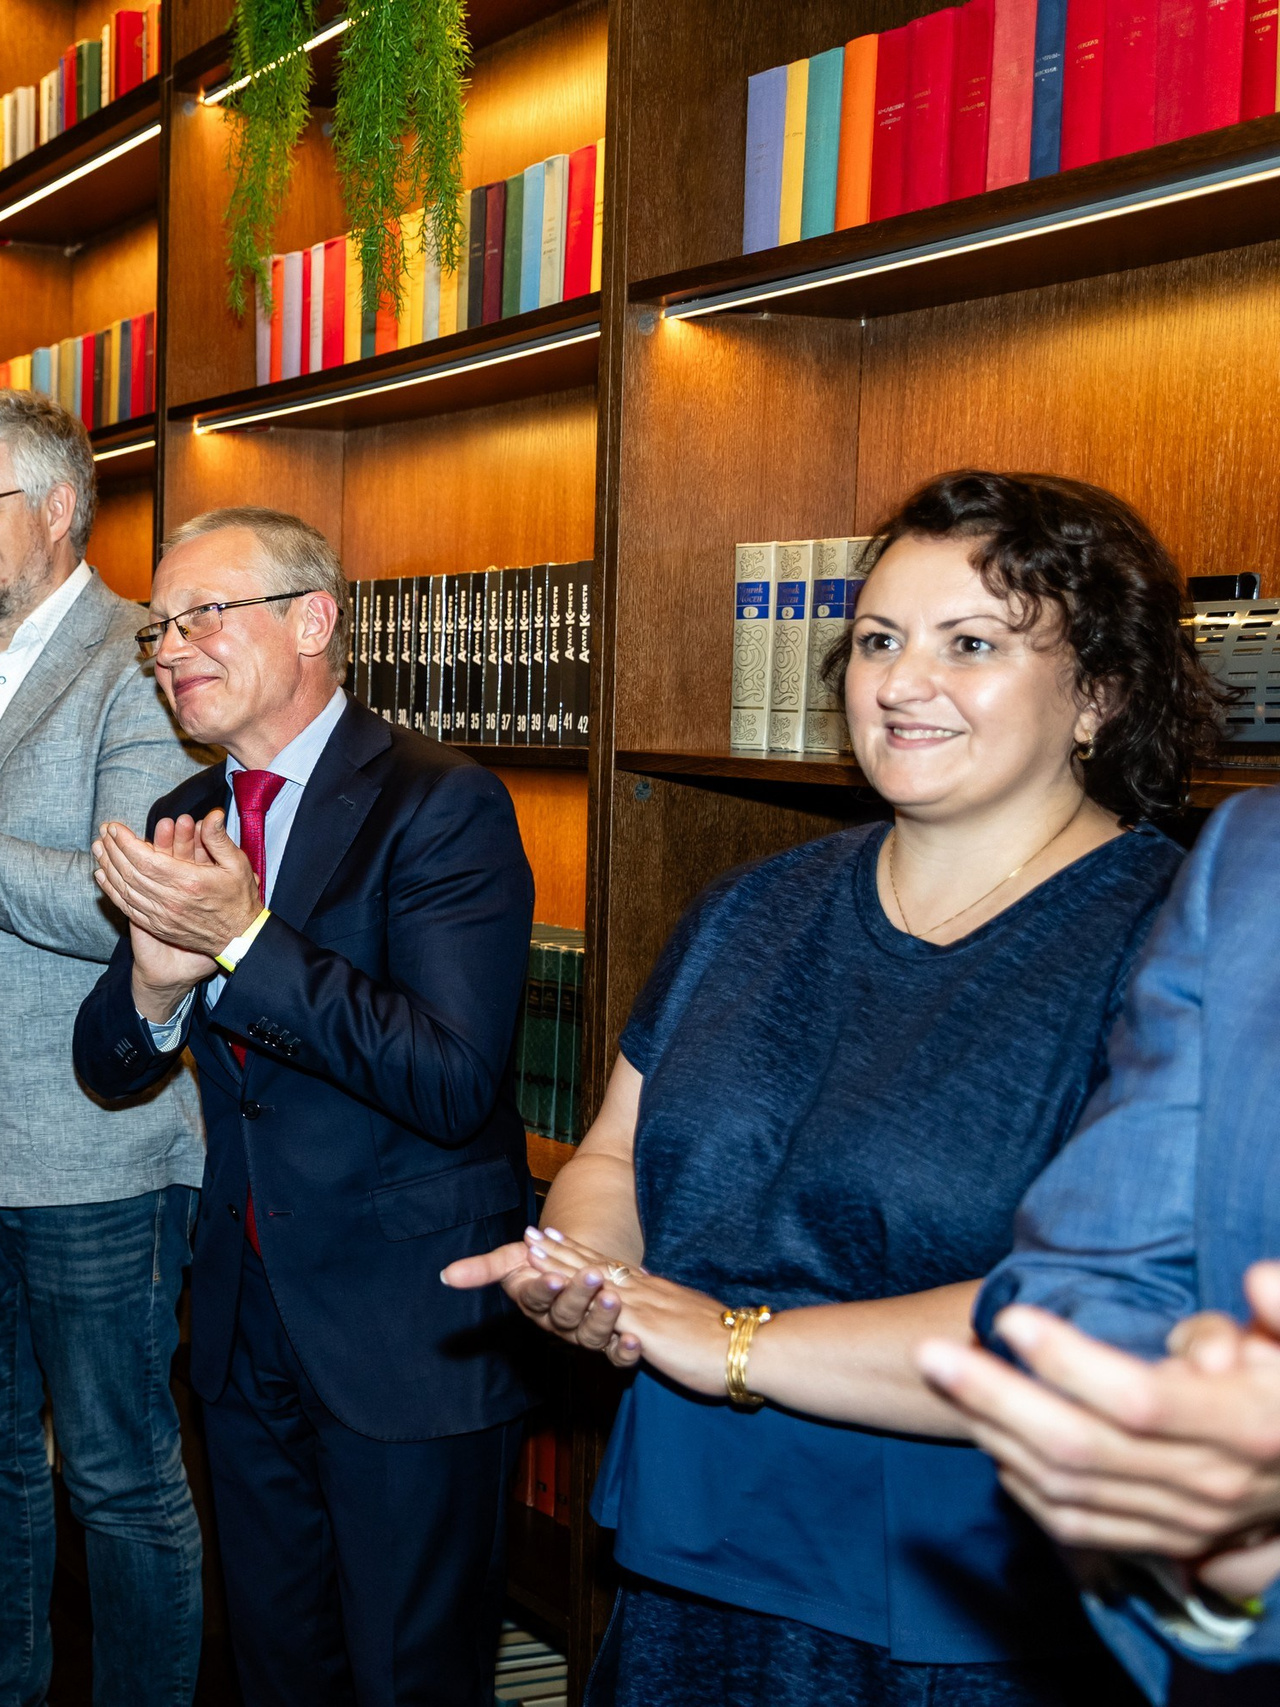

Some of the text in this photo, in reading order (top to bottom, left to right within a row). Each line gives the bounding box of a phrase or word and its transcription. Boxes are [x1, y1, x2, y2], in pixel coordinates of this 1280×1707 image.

[430, 711, 438, 727] 32
[443, 714, 450, 729] 33
[456, 712, 465, 728] 34
[471, 713, 479, 729] 35
[486, 713, 495, 729] 36
[502, 714, 511, 730] 37
[517, 715, 526, 732] 38
[531, 714, 541, 731] 39
[548, 714, 557, 731] 40
[563, 713, 572, 730] 41
[578, 716, 588, 733] 42
